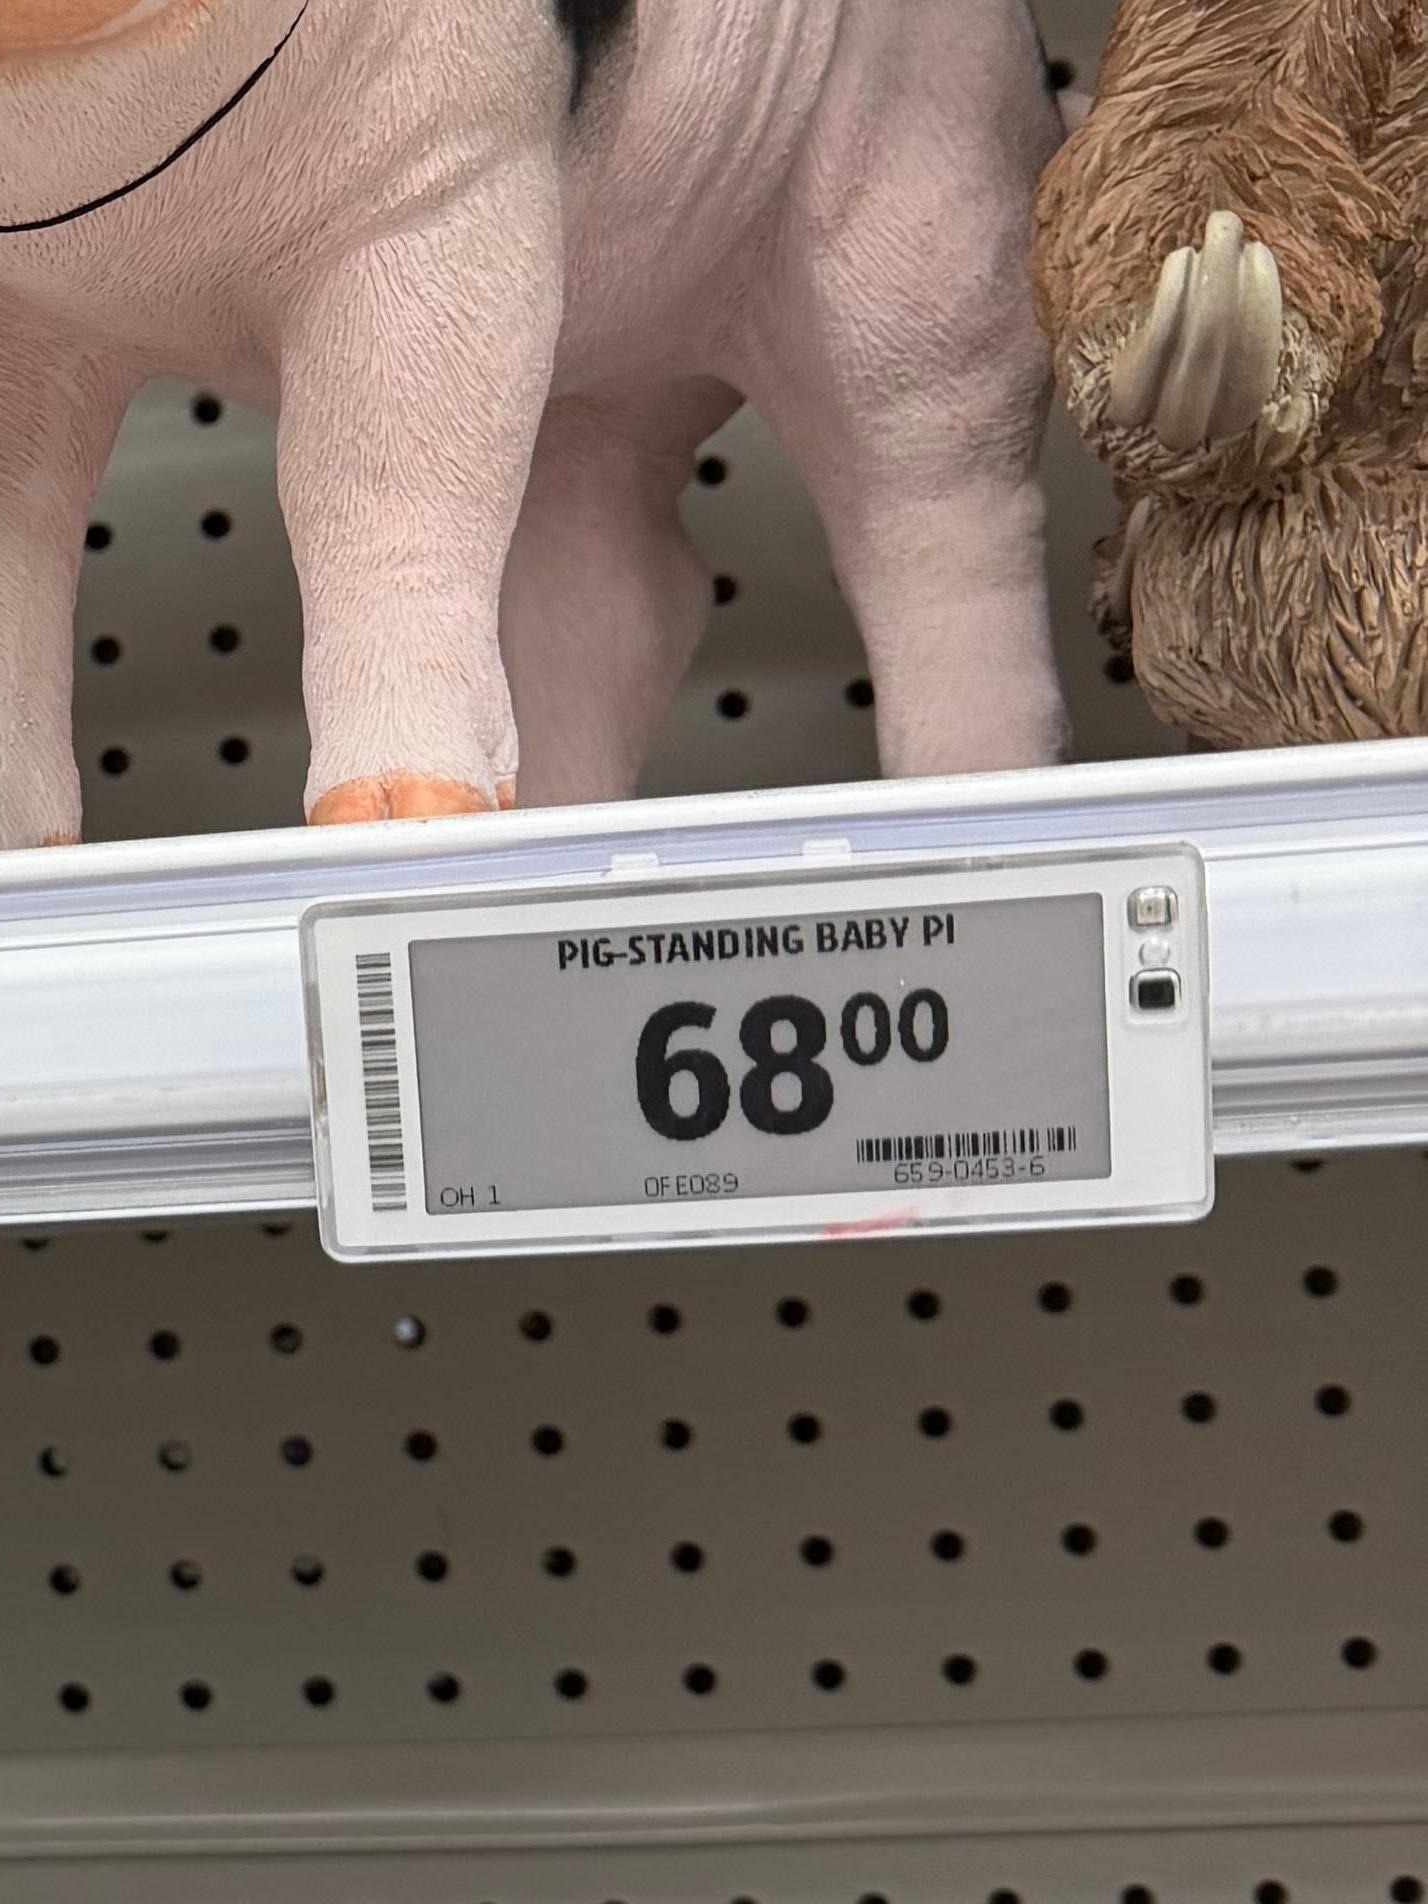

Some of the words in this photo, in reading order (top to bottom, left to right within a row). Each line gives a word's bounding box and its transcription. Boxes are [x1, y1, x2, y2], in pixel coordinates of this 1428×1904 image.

[557, 918, 804, 972] PIG-STANDING
[815, 914, 911, 955] BABY
[922, 912, 957, 947] PI
[893, 1156, 1045, 1185] 659-0453-6
[440, 1187, 476, 1208] OH
